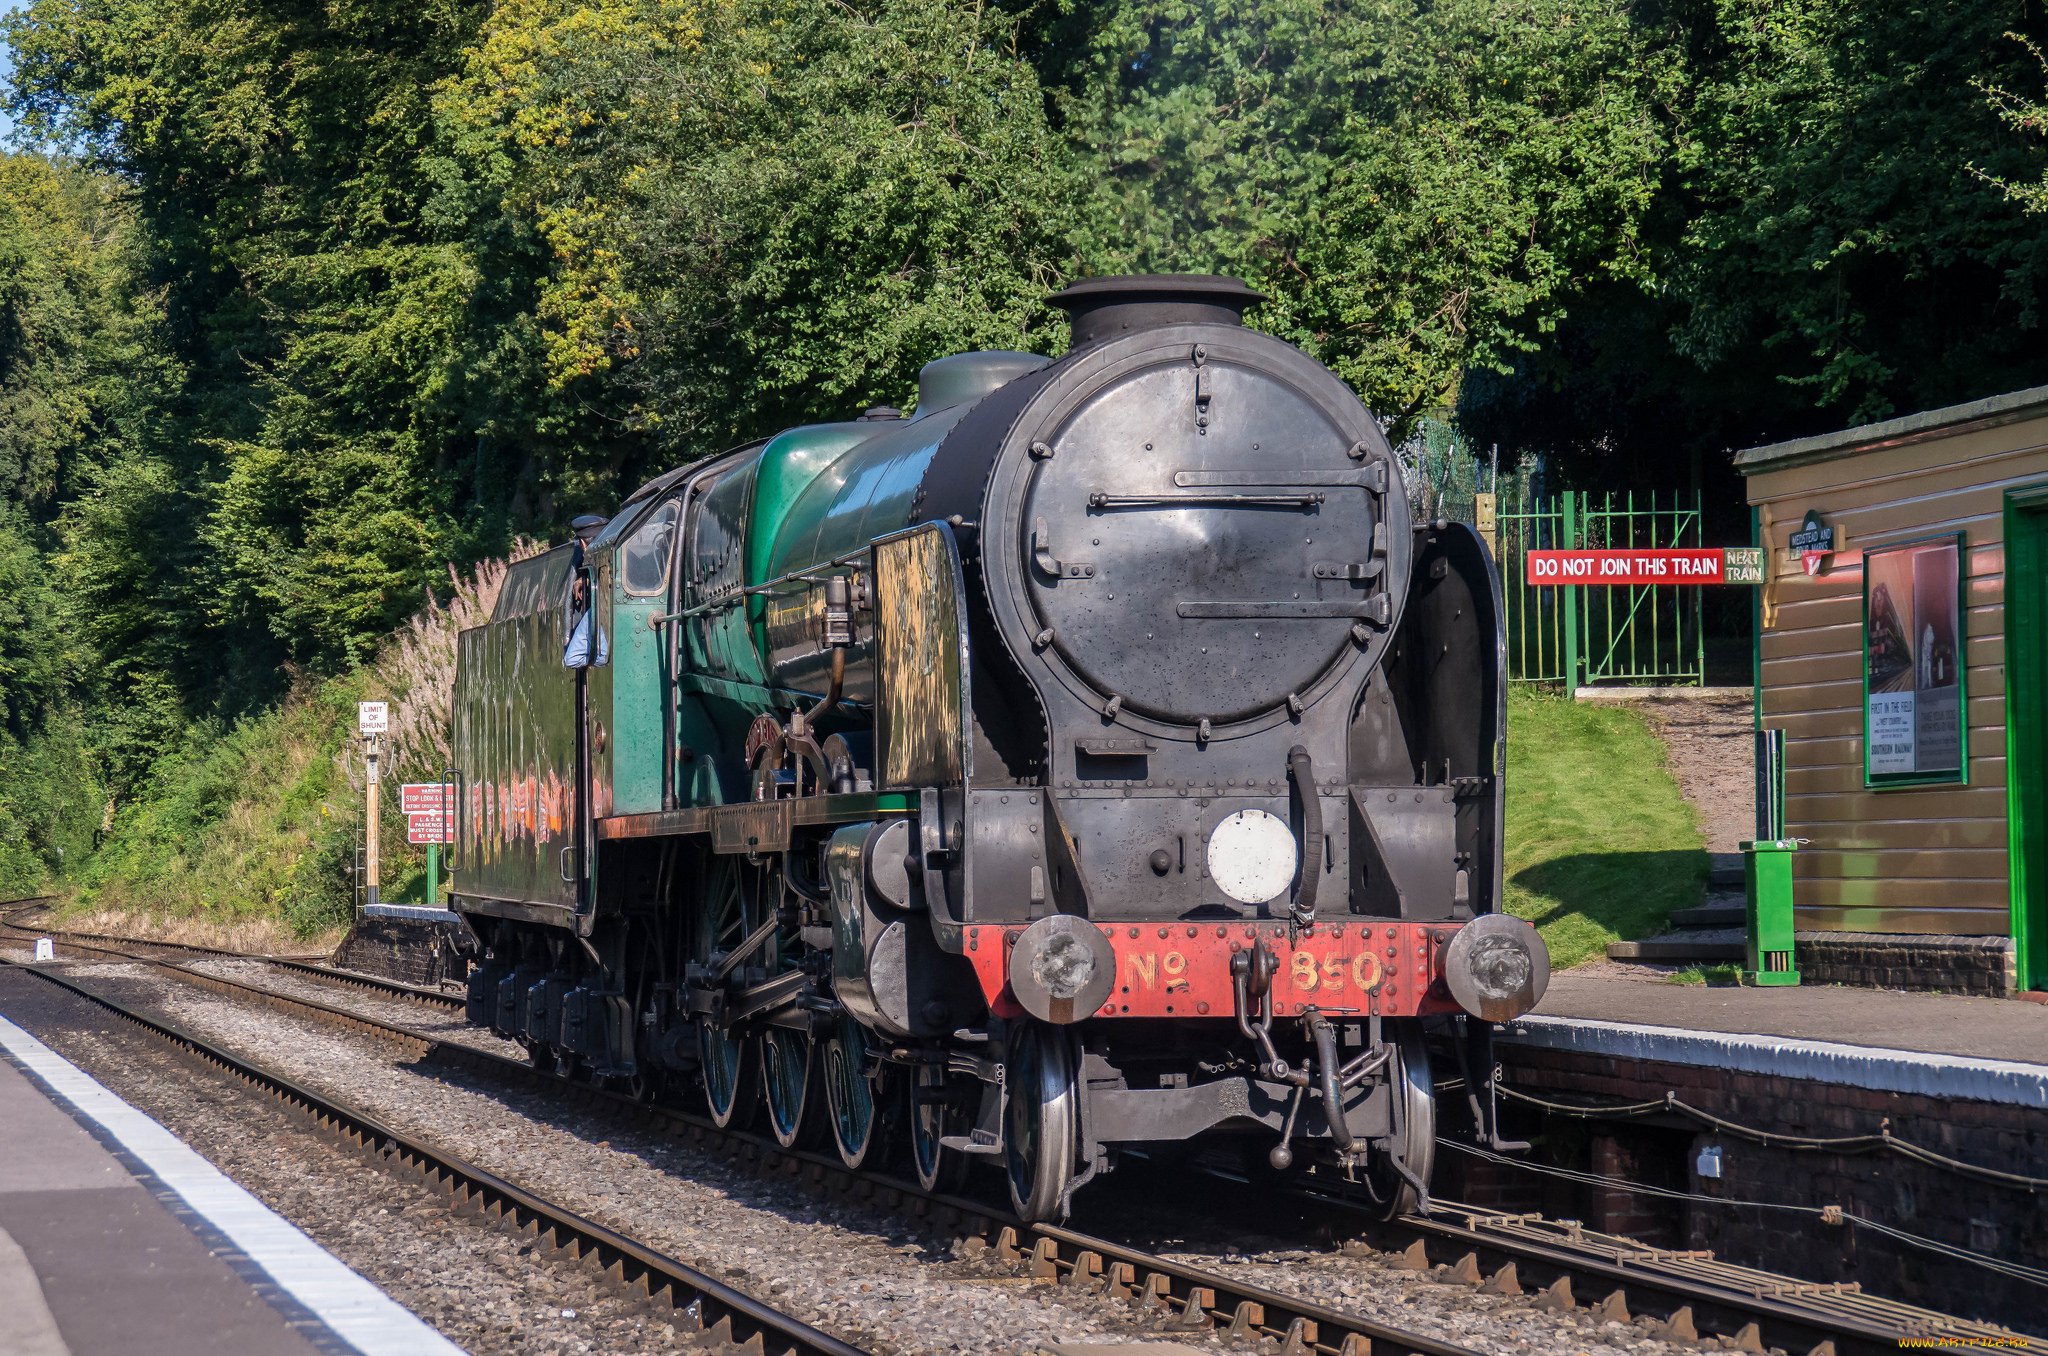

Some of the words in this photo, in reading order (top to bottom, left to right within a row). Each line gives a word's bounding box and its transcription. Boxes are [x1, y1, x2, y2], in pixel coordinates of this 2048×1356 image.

[1820, 528, 1832, 541] AND
[1726, 551, 1761, 565] NEXT
[1535, 558, 1558, 576] DO
[1562, 558, 1594, 576] NOT
[1599, 558, 1631, 575] JOIN
[1635, 558, 1667, 575] THIS
[1671, 557, 1718, 575] TRAIN
[1725, 567, 1762, 581] TRAIN
[420, 794, 433, 802] LOOK
[1291, 951, 1382, 991] 850
